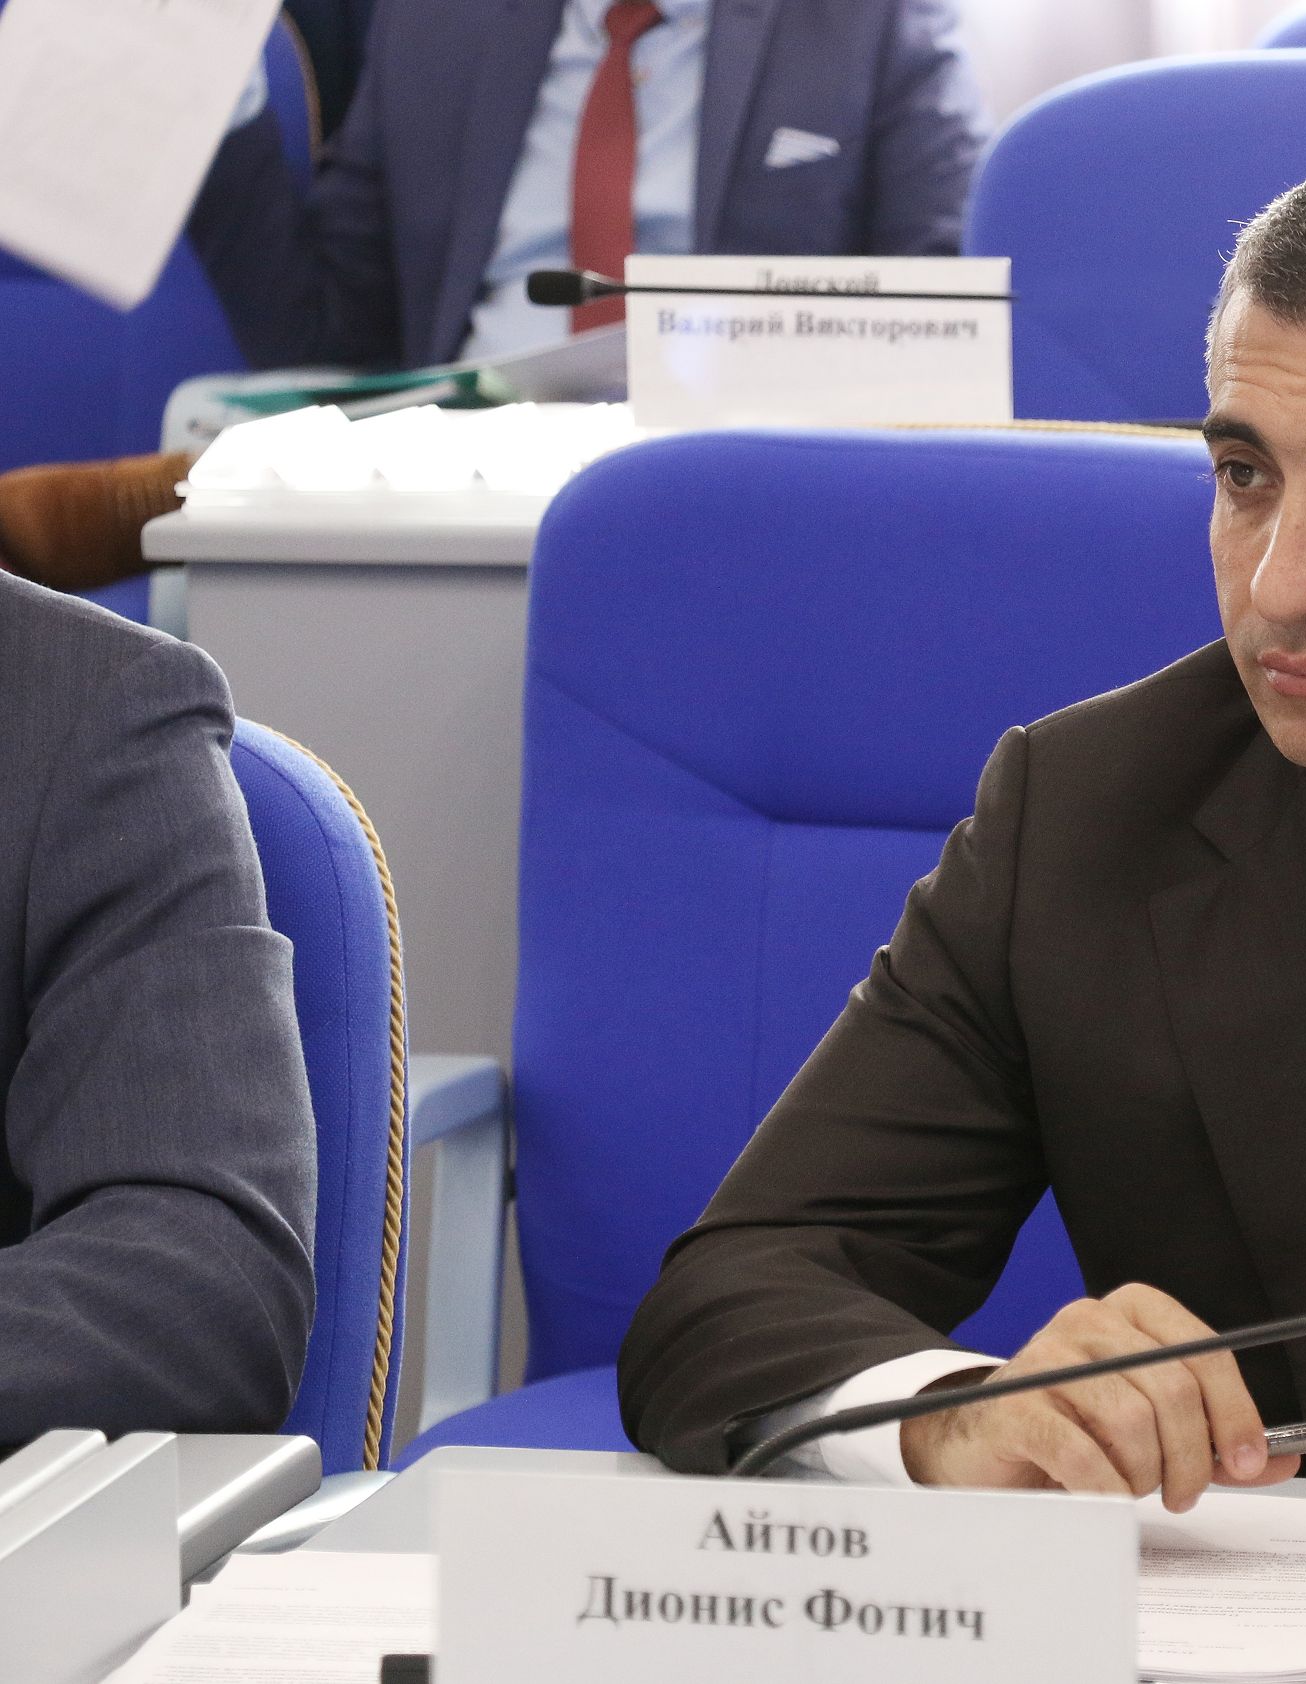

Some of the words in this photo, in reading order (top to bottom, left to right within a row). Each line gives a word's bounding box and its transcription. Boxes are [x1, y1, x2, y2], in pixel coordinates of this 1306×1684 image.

[657, 308, 785, 342] Валерий
[794, 309, 980, 343] Викторович
[696, 1507, 870, 1560] Айтов
[576, 1573, 785, 1630] Дионис
[803, 1587, 986, 1641] Фотич
